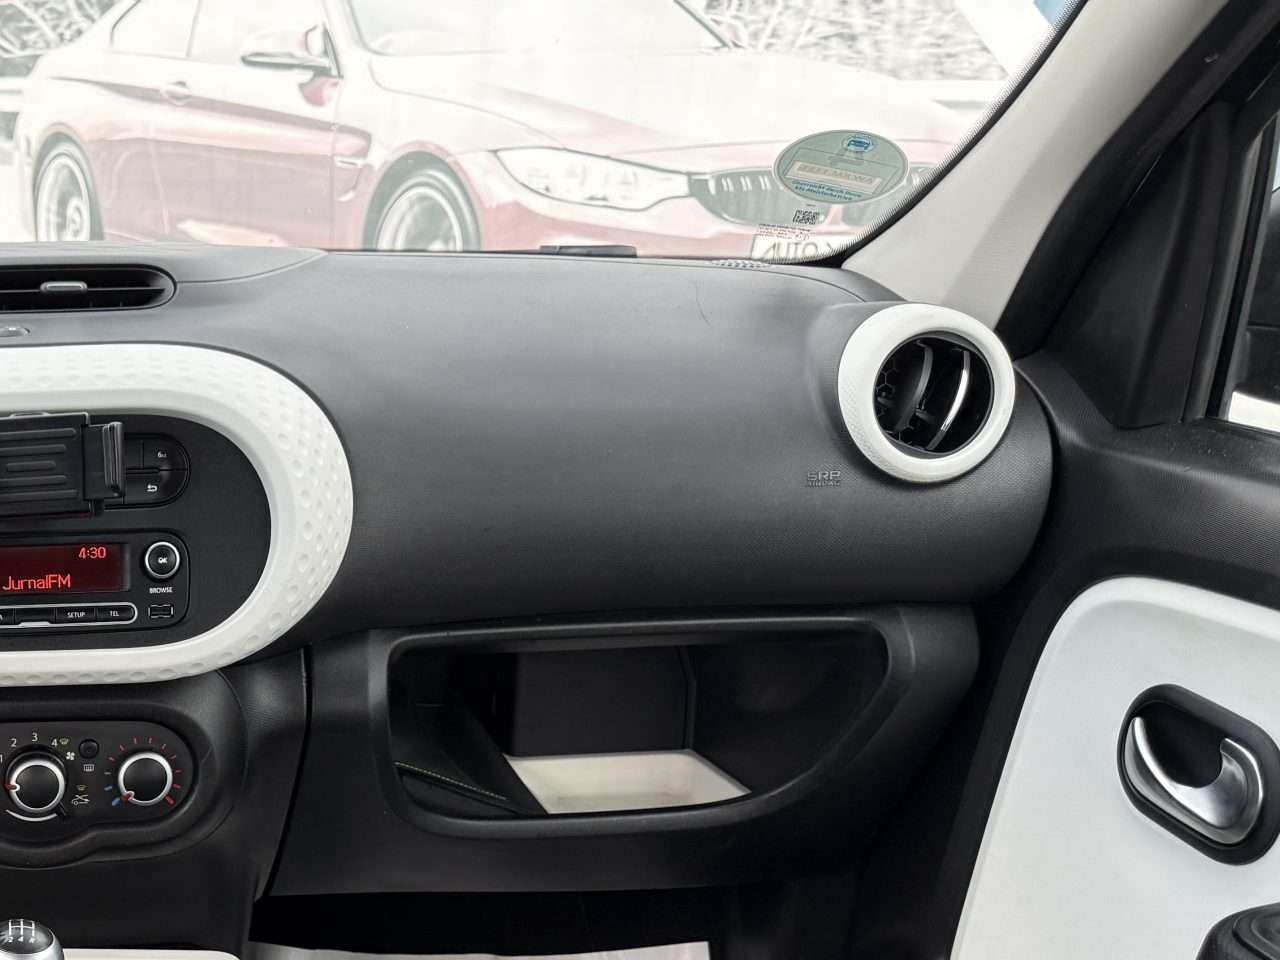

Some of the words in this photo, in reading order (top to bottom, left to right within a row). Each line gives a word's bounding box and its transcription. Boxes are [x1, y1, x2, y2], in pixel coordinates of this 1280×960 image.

[762, 241, 819, 261] AUTO
[78, 546, 107, 560] 4:30
[2, 573, 71, 591] JurnalFM
[149, 586, 173, 594] BROWSE
[67, 611, 87, 619] SETUP
[109, 609, 121, 618] TEL
[10, 737, 18, 748] 2
[31, 732, 39, 742] 3
[51, 738, 59, 748] 4
